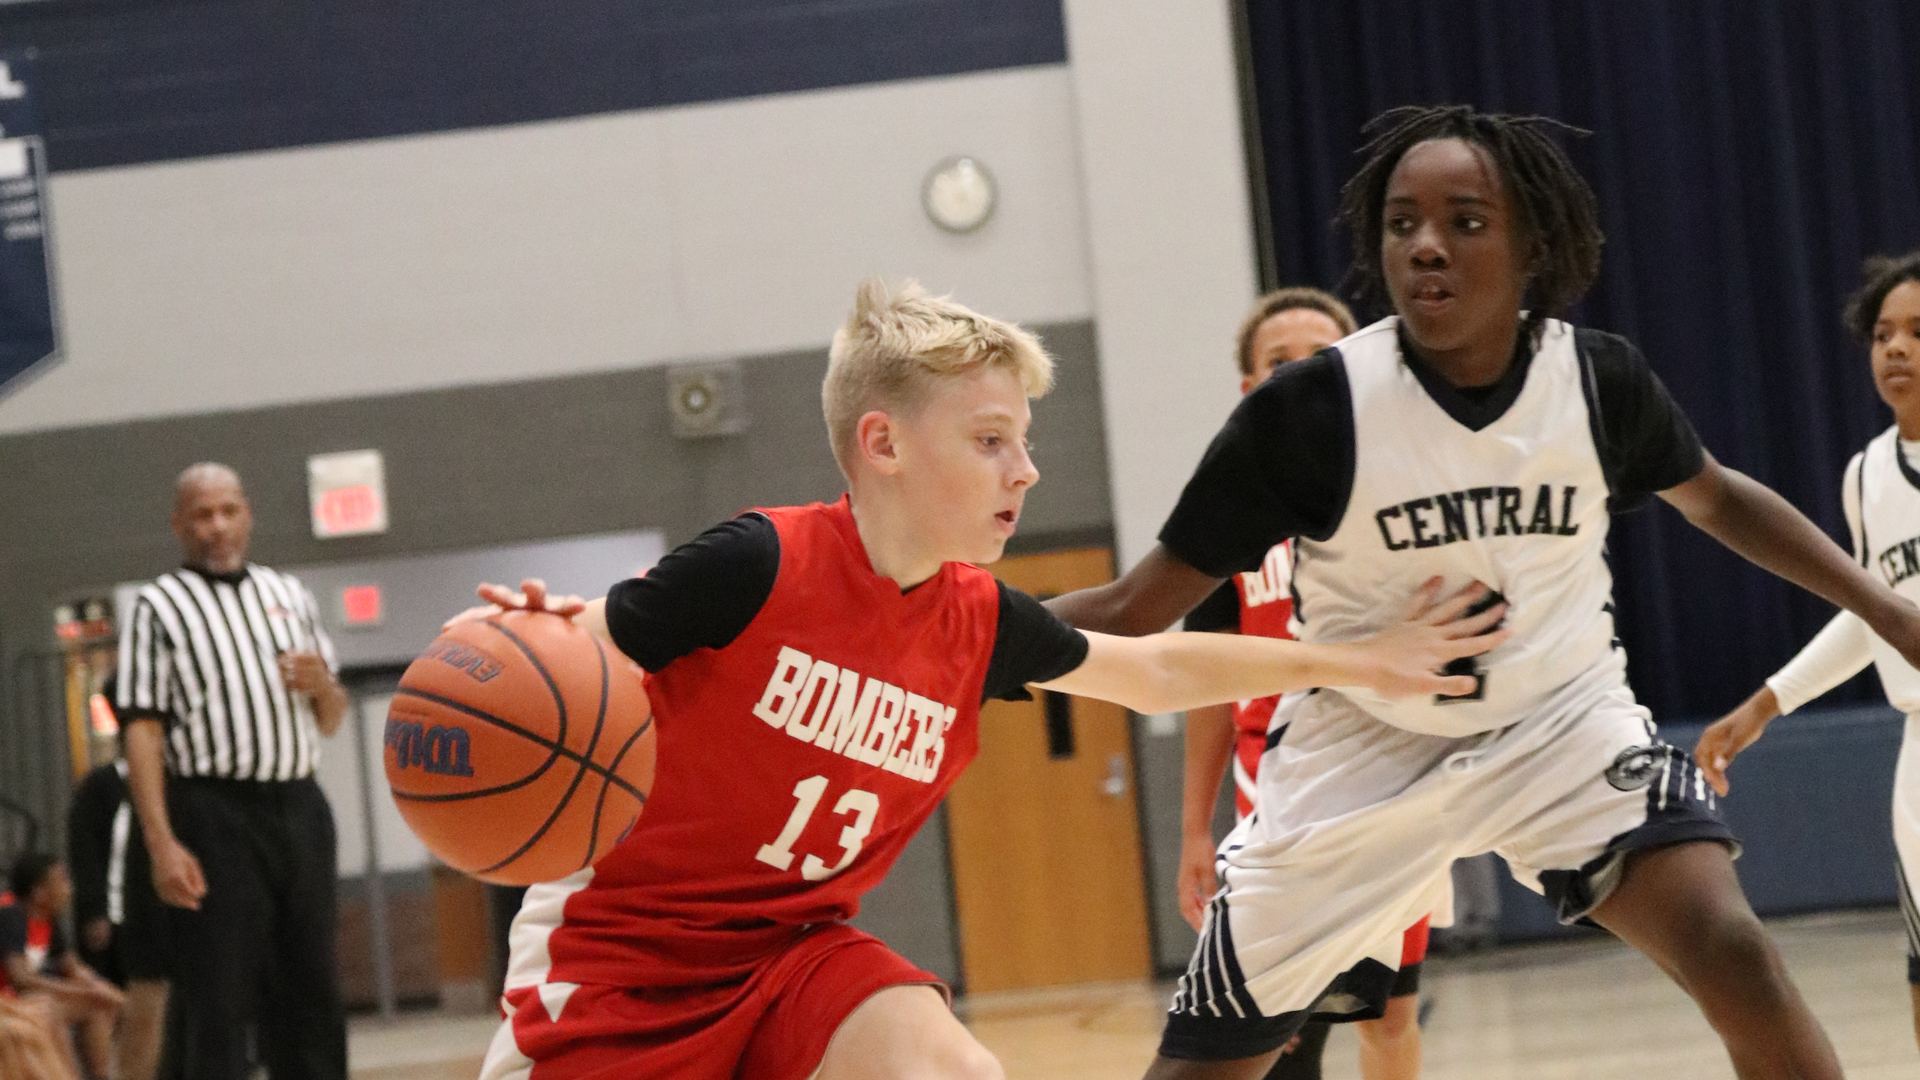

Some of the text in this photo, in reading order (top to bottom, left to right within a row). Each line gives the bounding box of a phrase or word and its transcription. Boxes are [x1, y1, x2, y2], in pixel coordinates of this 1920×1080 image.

[1375, 484, 1579, 551] CENTRAL
[1879, 535, 1920, 589] CEN
[752, 645, 957, 784] BOMBERS
[755, 774, 880, 882] 13
